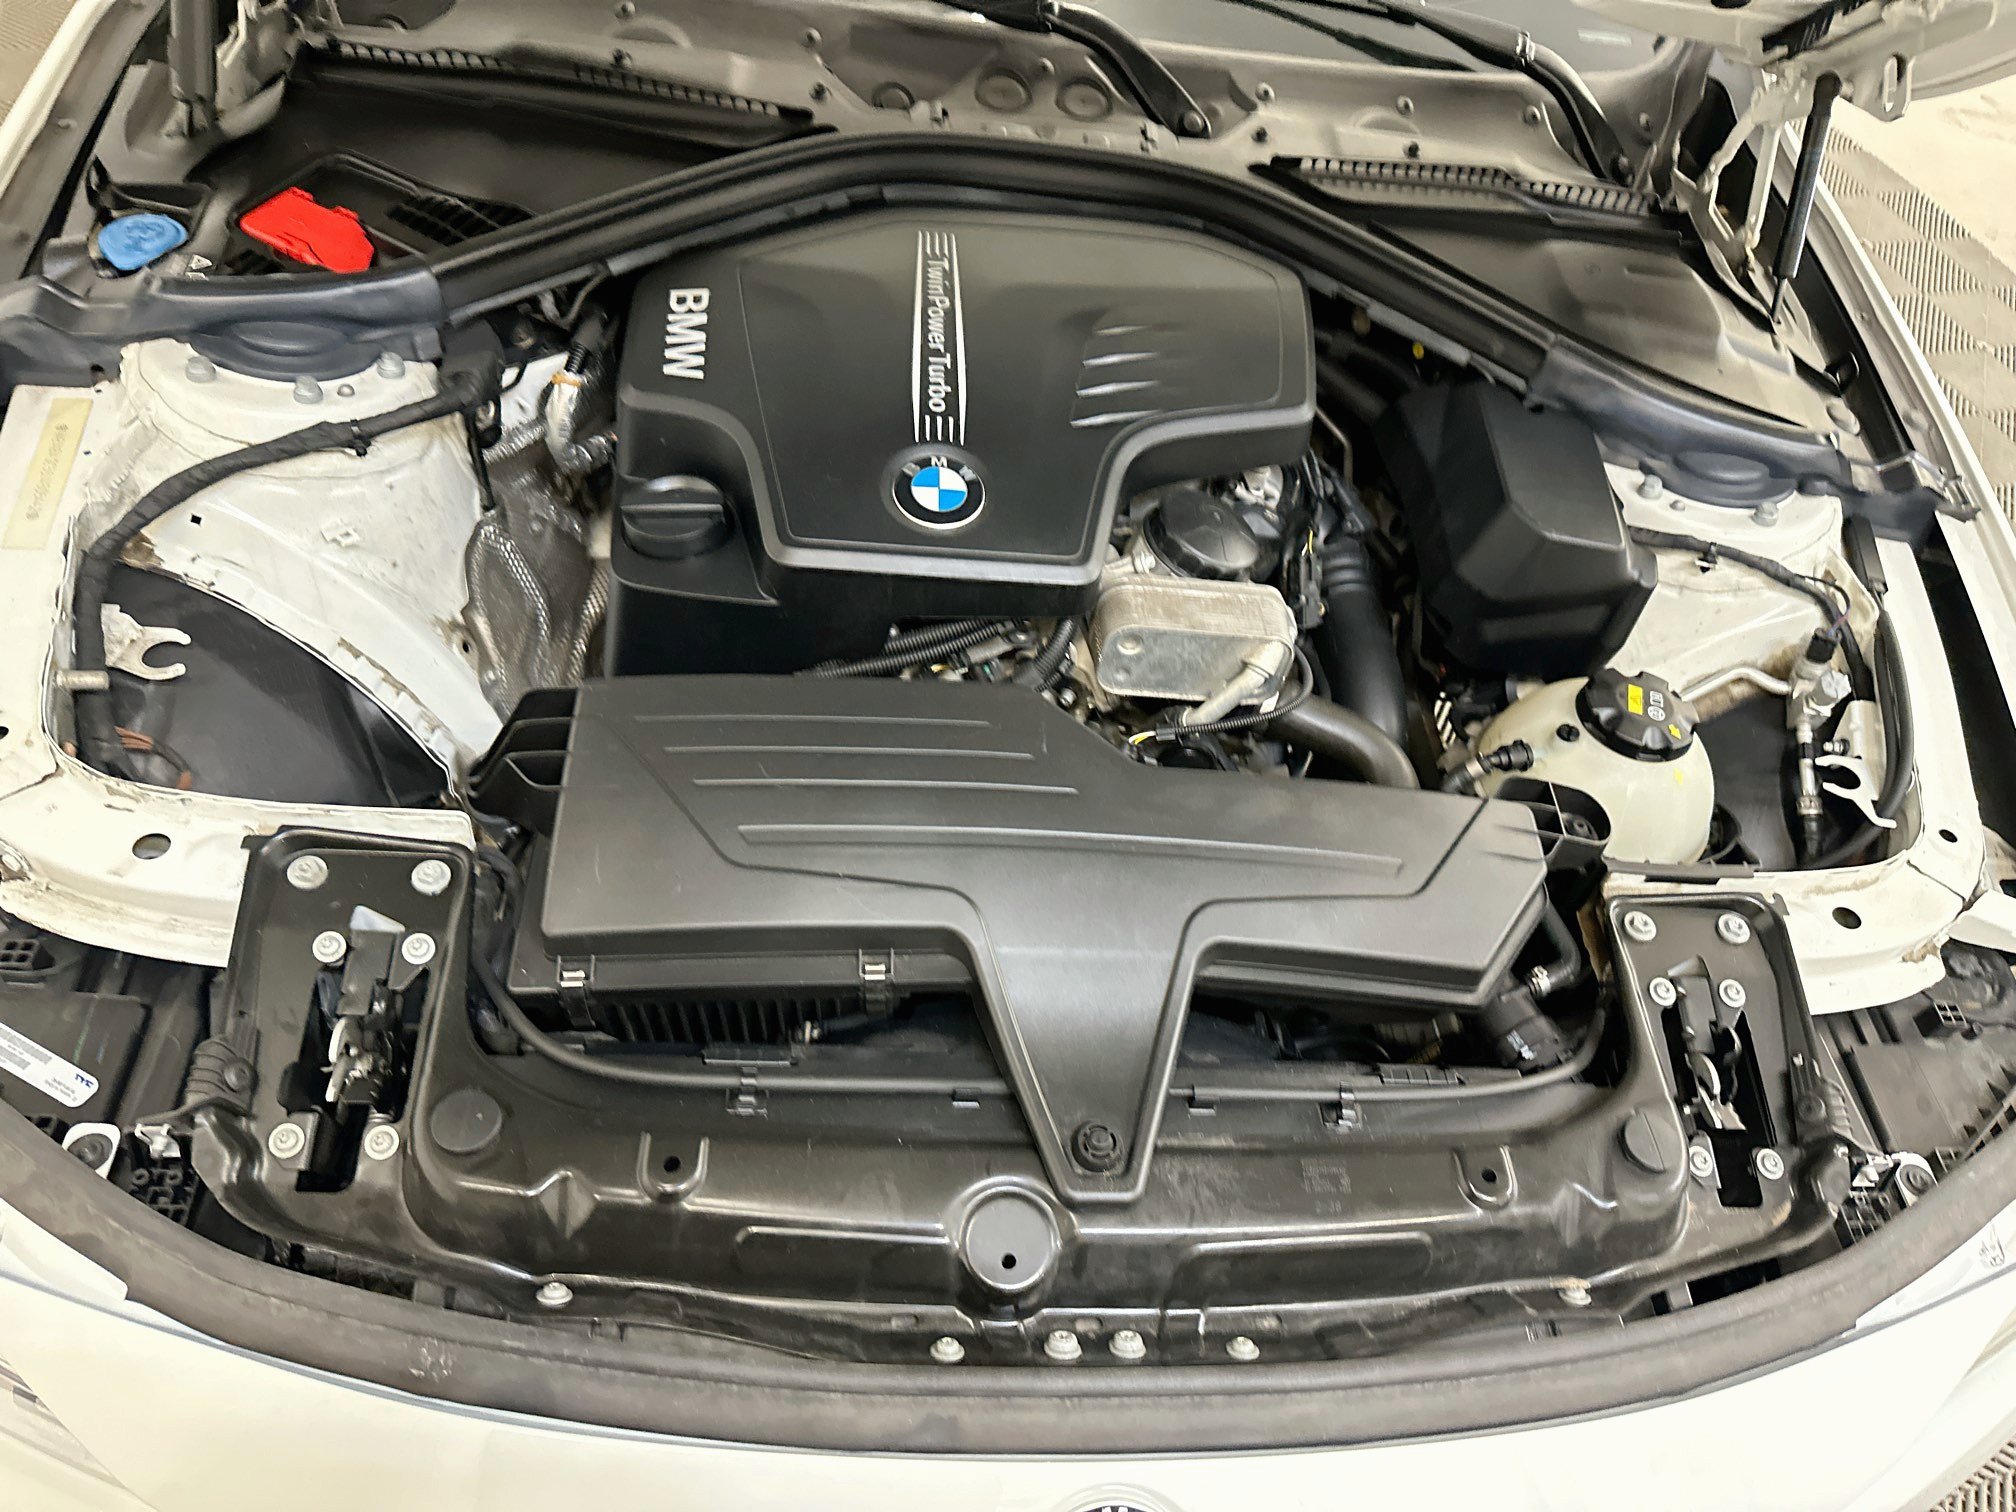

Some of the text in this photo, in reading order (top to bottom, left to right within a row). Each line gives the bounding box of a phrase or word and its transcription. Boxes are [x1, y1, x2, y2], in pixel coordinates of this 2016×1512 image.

[663, 288, 710, 380] BMW
[928, 353, 951, 413] Turbo
[901, 455, 977, 482] BMW
